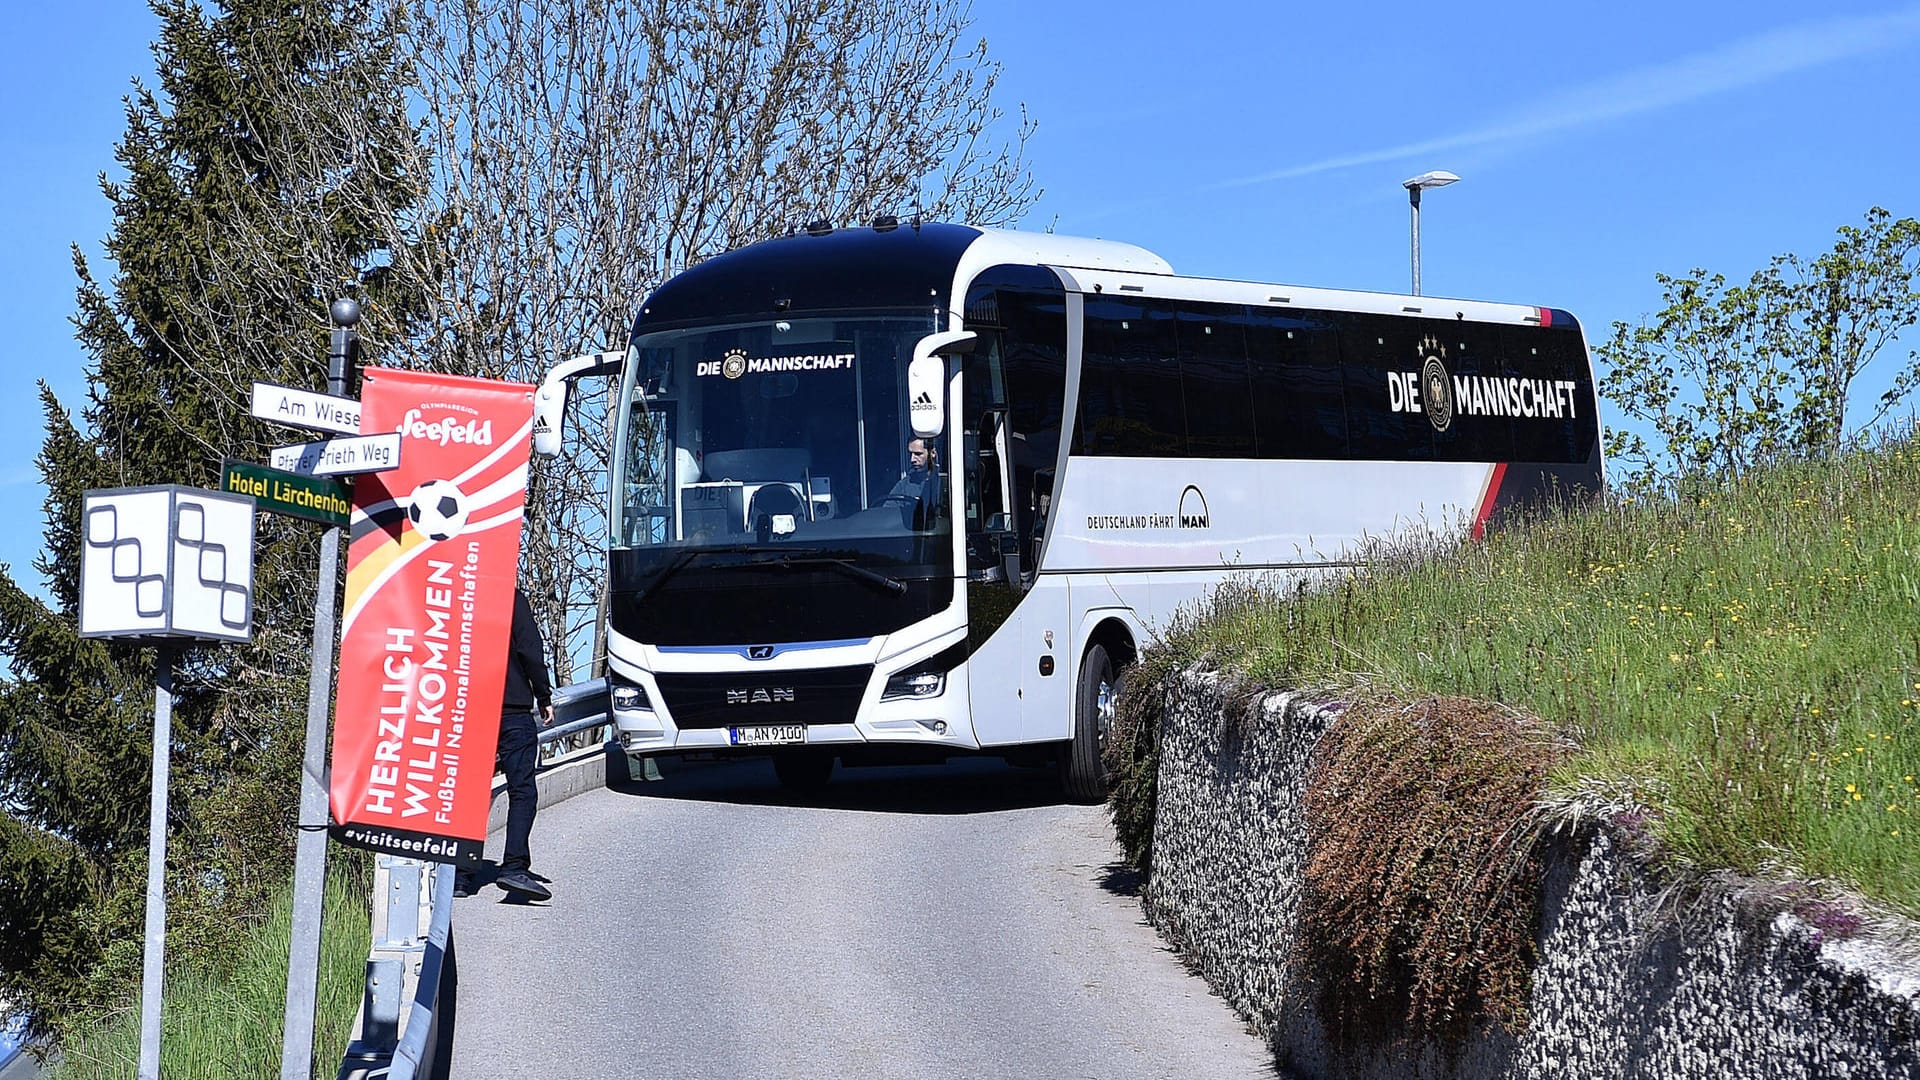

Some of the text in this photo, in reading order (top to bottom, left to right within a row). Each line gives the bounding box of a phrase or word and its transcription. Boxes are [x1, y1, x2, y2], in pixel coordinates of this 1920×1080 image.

[696, 354, 855, 376] DIE MANNSCHAFT
[1387, 371, 1422, 413] DIE
[1453, 375, 1576, 418] MANNSCHAFT
[278, 396, 360, 427] Am Wiese
[396, 408, 493, 447] Seefeld
[319, 446, 355, 467] Prieth
[363, 443, 390, 465] Weg
[229, 471, 350, 515] Hotel Lärchenho
[1087, 513, 1207, 529] DEUTSCHLAND FÄHRT MAN
[401, 559, 454, 817] WILLKOMMEN
[434, 541, 480, 824] Fußball Nationalmannschaften
[726, 687, 795, 704] MAN
[365, 627, 415, 814] HERZLICH
[771, 726, 802, 740] 9100
[345, 829, 458, 857] #visitseefeld
